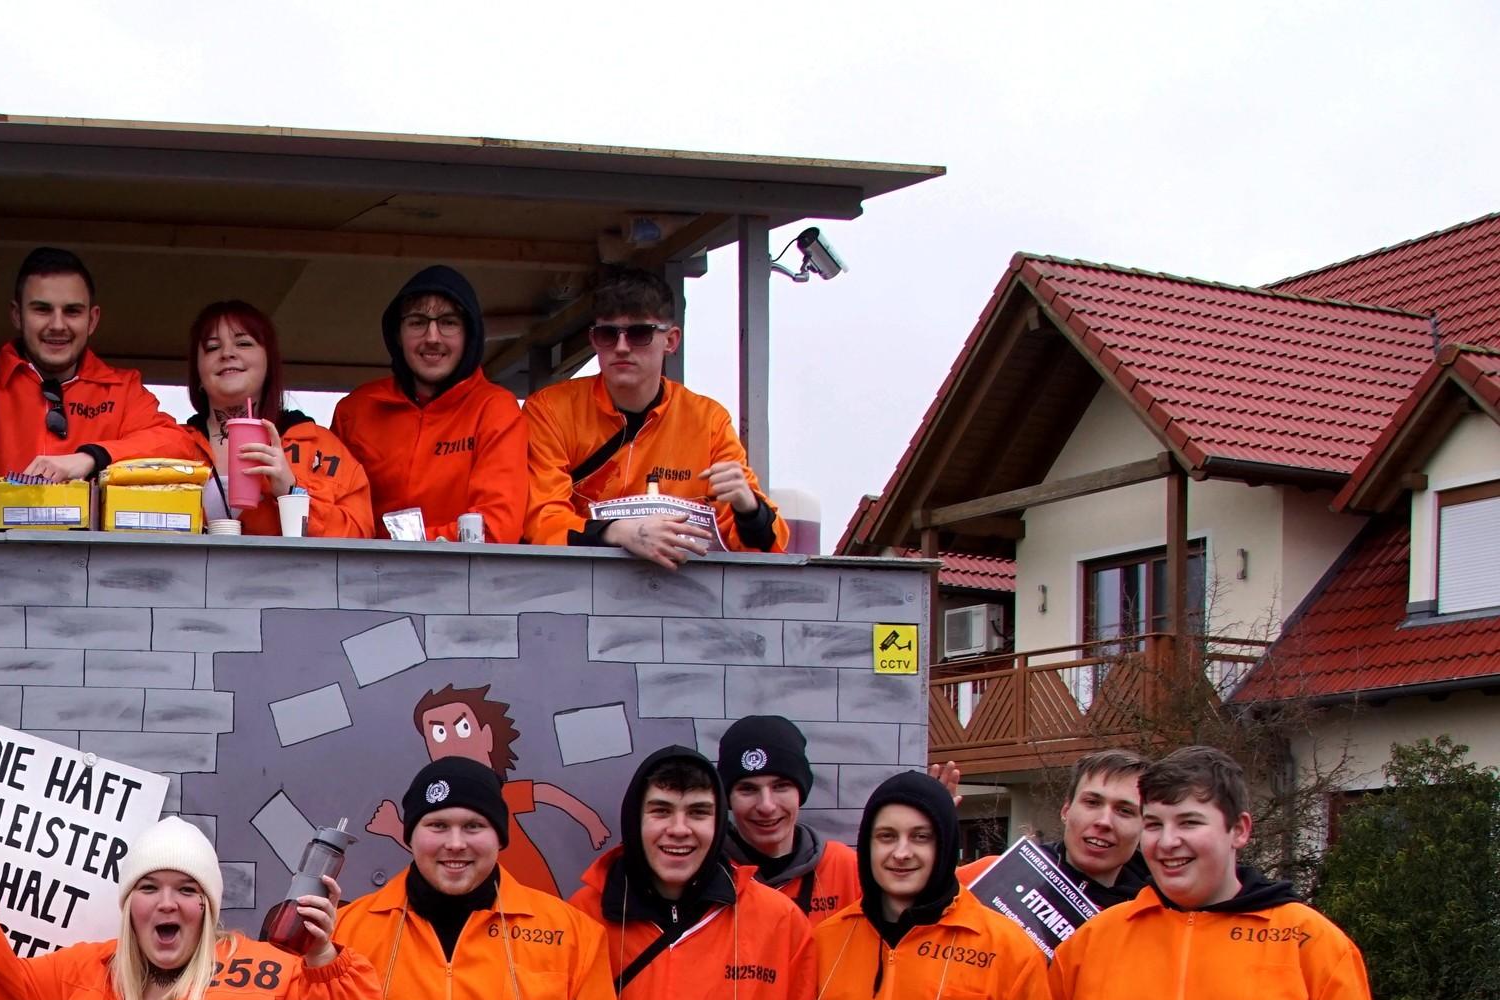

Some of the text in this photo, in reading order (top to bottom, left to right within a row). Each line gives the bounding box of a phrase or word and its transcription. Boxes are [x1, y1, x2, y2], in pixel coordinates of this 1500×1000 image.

[601, 508, 631, 517] MUHRER
[880, 659, 910, 669] CCTV
[44, 756, 142, 822] HAFT
[1019, 844, 1047, 873] MUHRER
[1020, 888, 1076, 942] FITZNER
[488, 923, 564, 946] 603297
[917, 941, 997, 968] 6103297
[724, 965, 777, 984] 3825869
